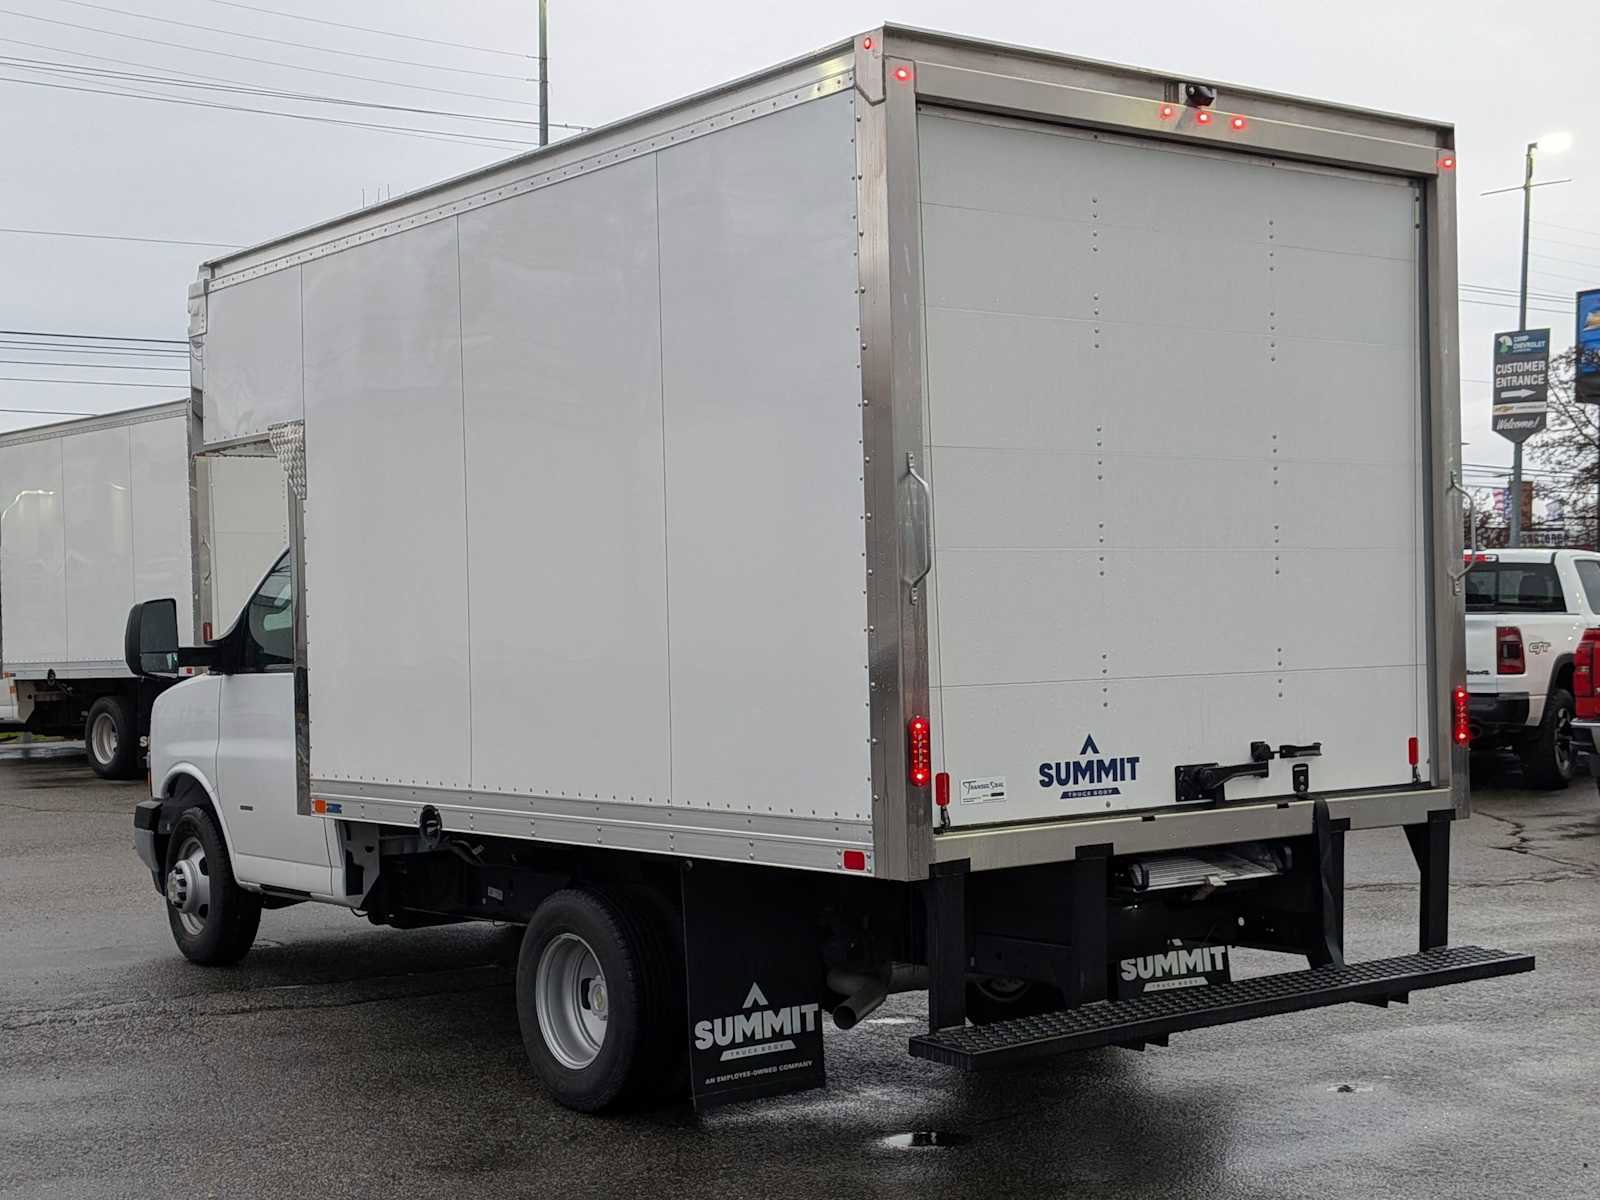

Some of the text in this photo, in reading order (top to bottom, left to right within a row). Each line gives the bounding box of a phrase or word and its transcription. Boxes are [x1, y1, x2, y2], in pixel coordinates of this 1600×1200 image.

[1495, 361, 1546, 375] CUSTOMER
[1495, 374, 1546, 388] ENTRANCE
[1496, 416, 1541, 430] Welcome!
[1039, 757, 1140, 788] SUMMIT
[1120, 945, 1226, 981] SUMMIT
[694, 1003, 819, 1050] SUMMIT
[716, 1067, 778, 1083] EMPLOYEE-OWNED
[778, 1060, 814, 1072] COMPANY
